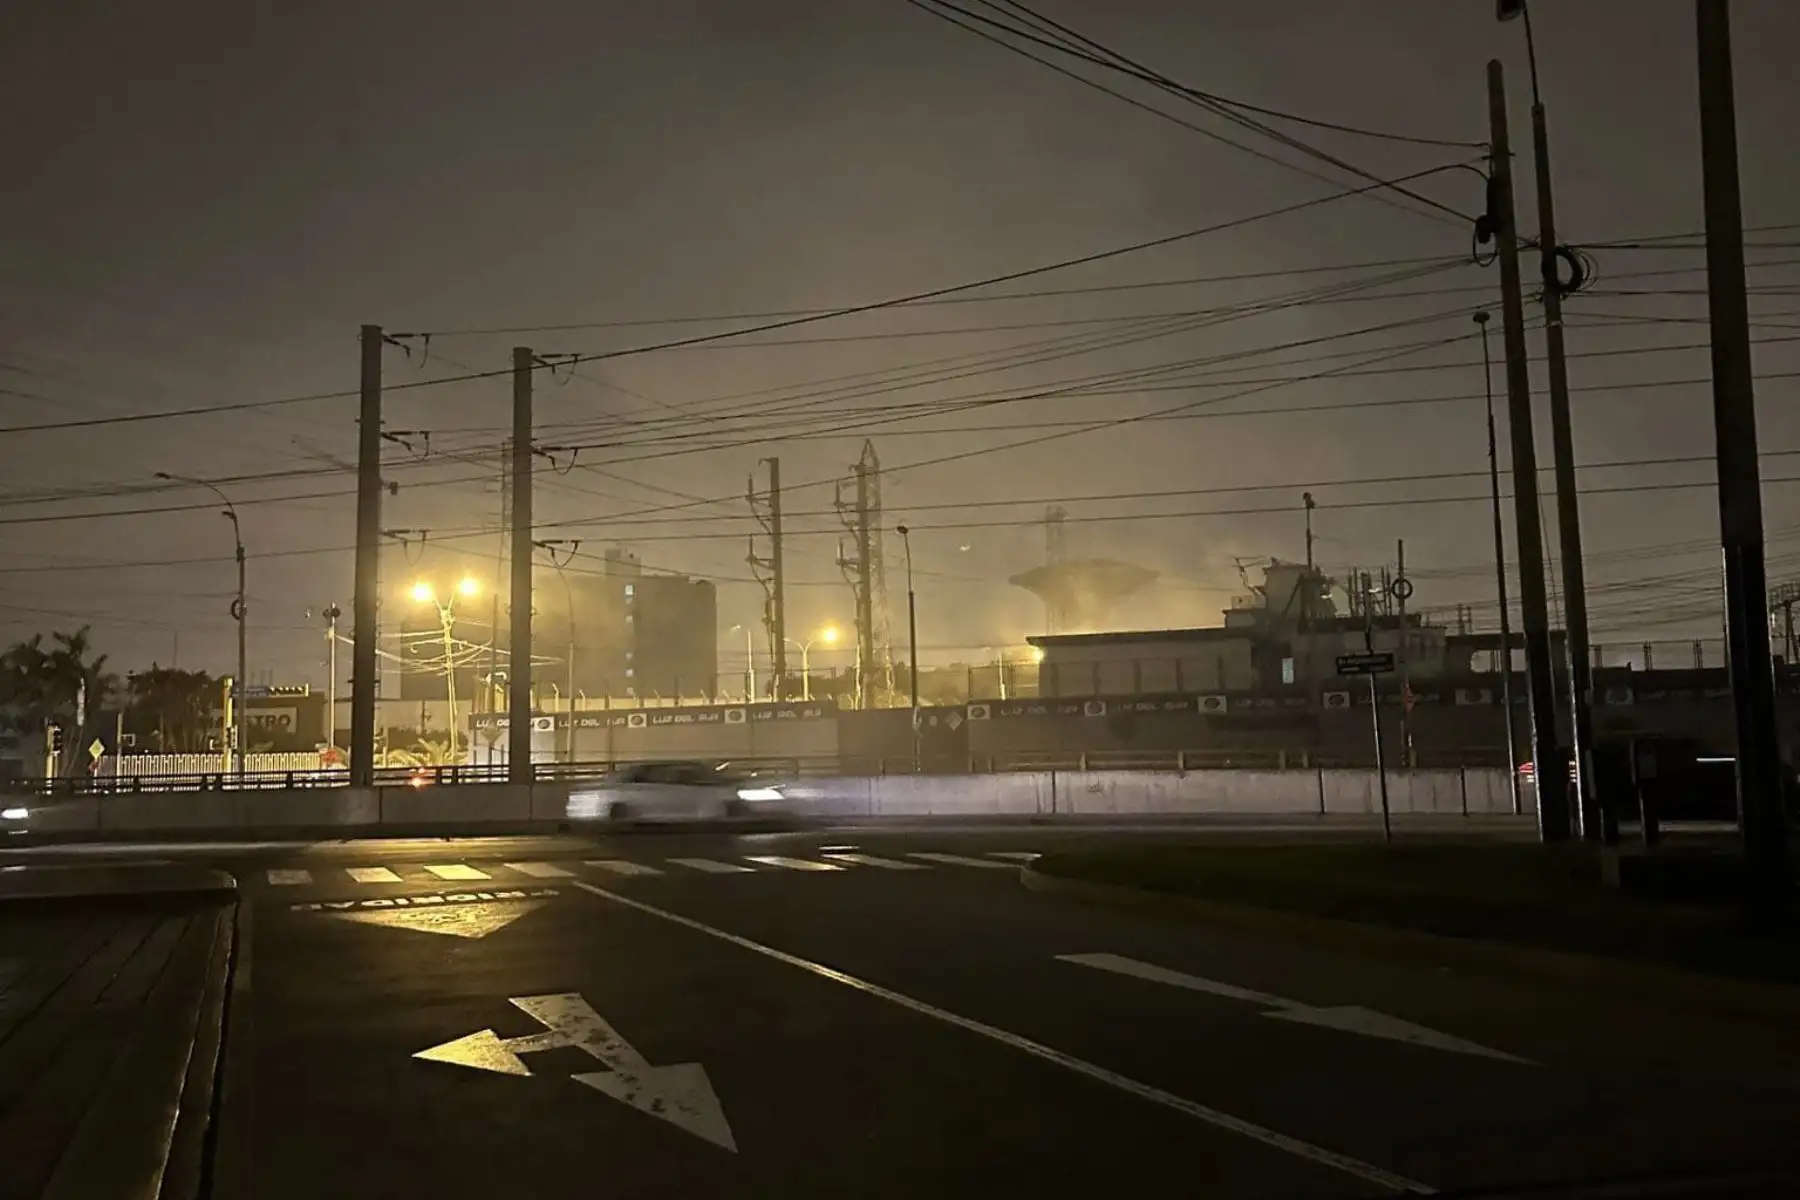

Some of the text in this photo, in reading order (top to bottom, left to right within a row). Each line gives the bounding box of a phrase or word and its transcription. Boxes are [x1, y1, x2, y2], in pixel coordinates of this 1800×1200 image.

[475, 718, 511, 729] LU DE
[652, 715, 673, 725] LUZ
[674, 714, 695, 723] DEL
